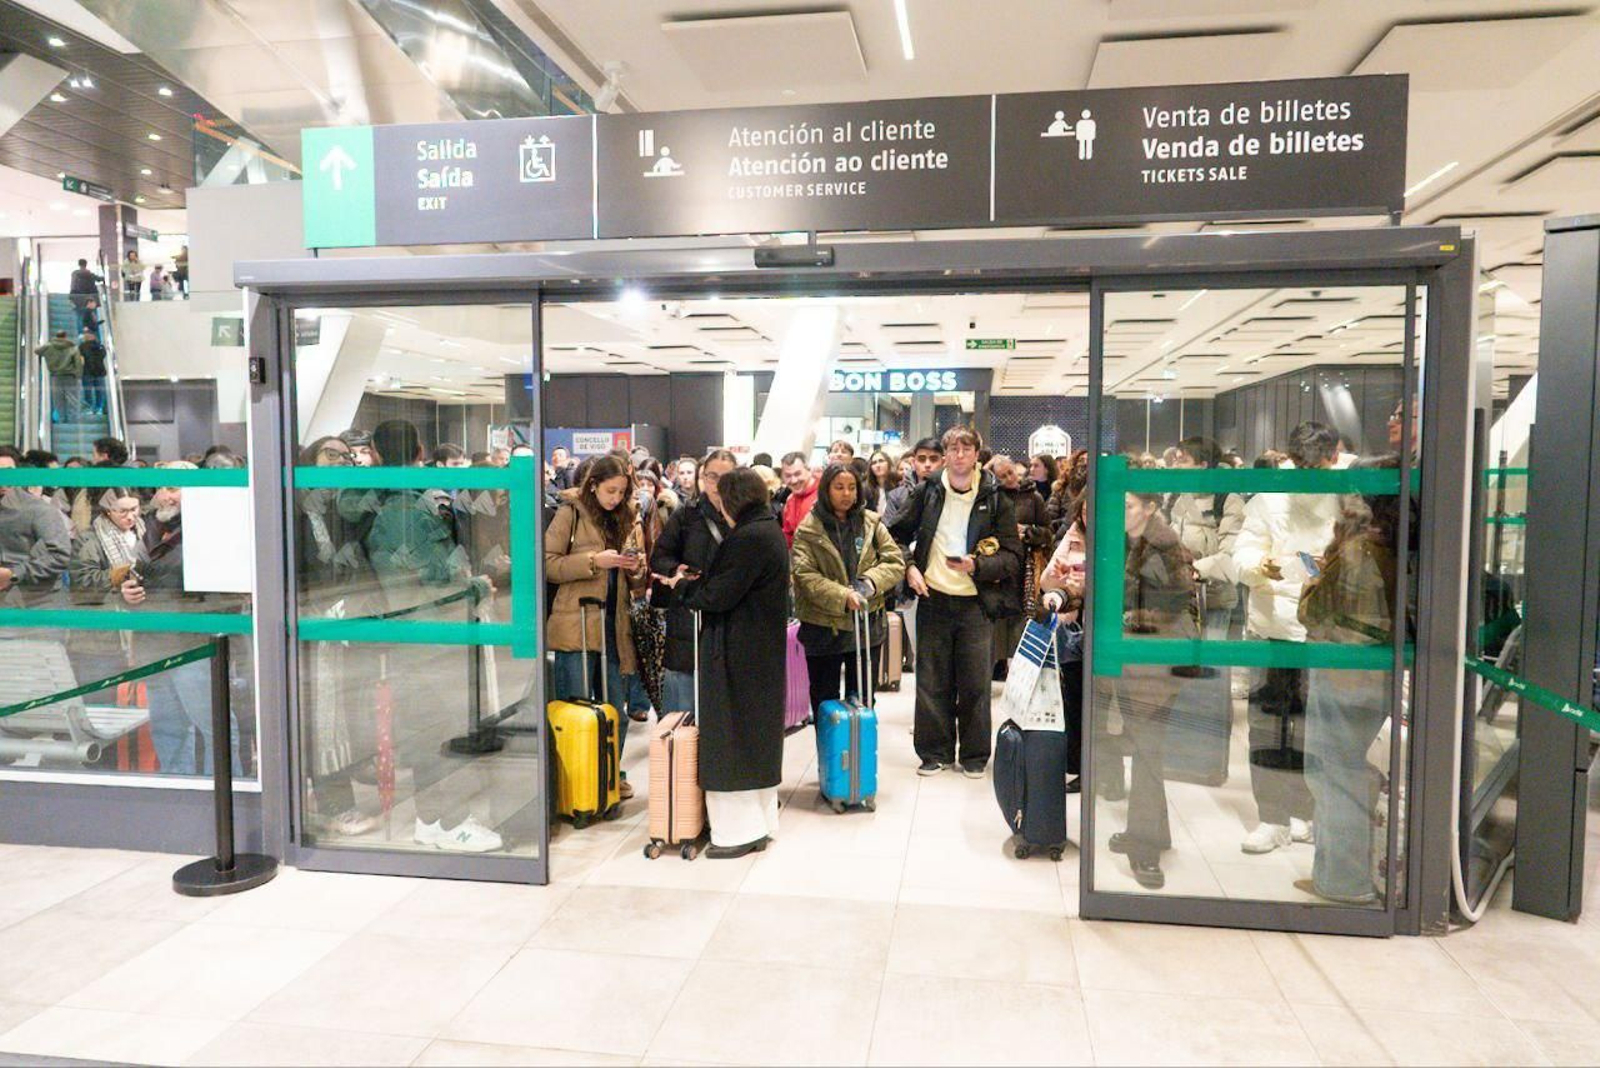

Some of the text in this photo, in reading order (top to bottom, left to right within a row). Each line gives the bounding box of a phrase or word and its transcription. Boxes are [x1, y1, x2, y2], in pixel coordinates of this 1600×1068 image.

[1143, 99, 1351, 129] Venta de billetes
[729, 119, 936, 148] Atención al cliente
[1142, 130, 1365, 160] Venda de billetes
[416, 138, 477, 161] Salida
[729, 148, 949, 177] Atención ao cliente
[416, 166, 474, 189] Saída
[1141, 165, 1249, 184] TICKETS SALE
[728, 181, 867, 199] CUSTOMER SERVICE
[417, 196, 448, 211] EXIT
[889, 371, 958, 392] BOSS
